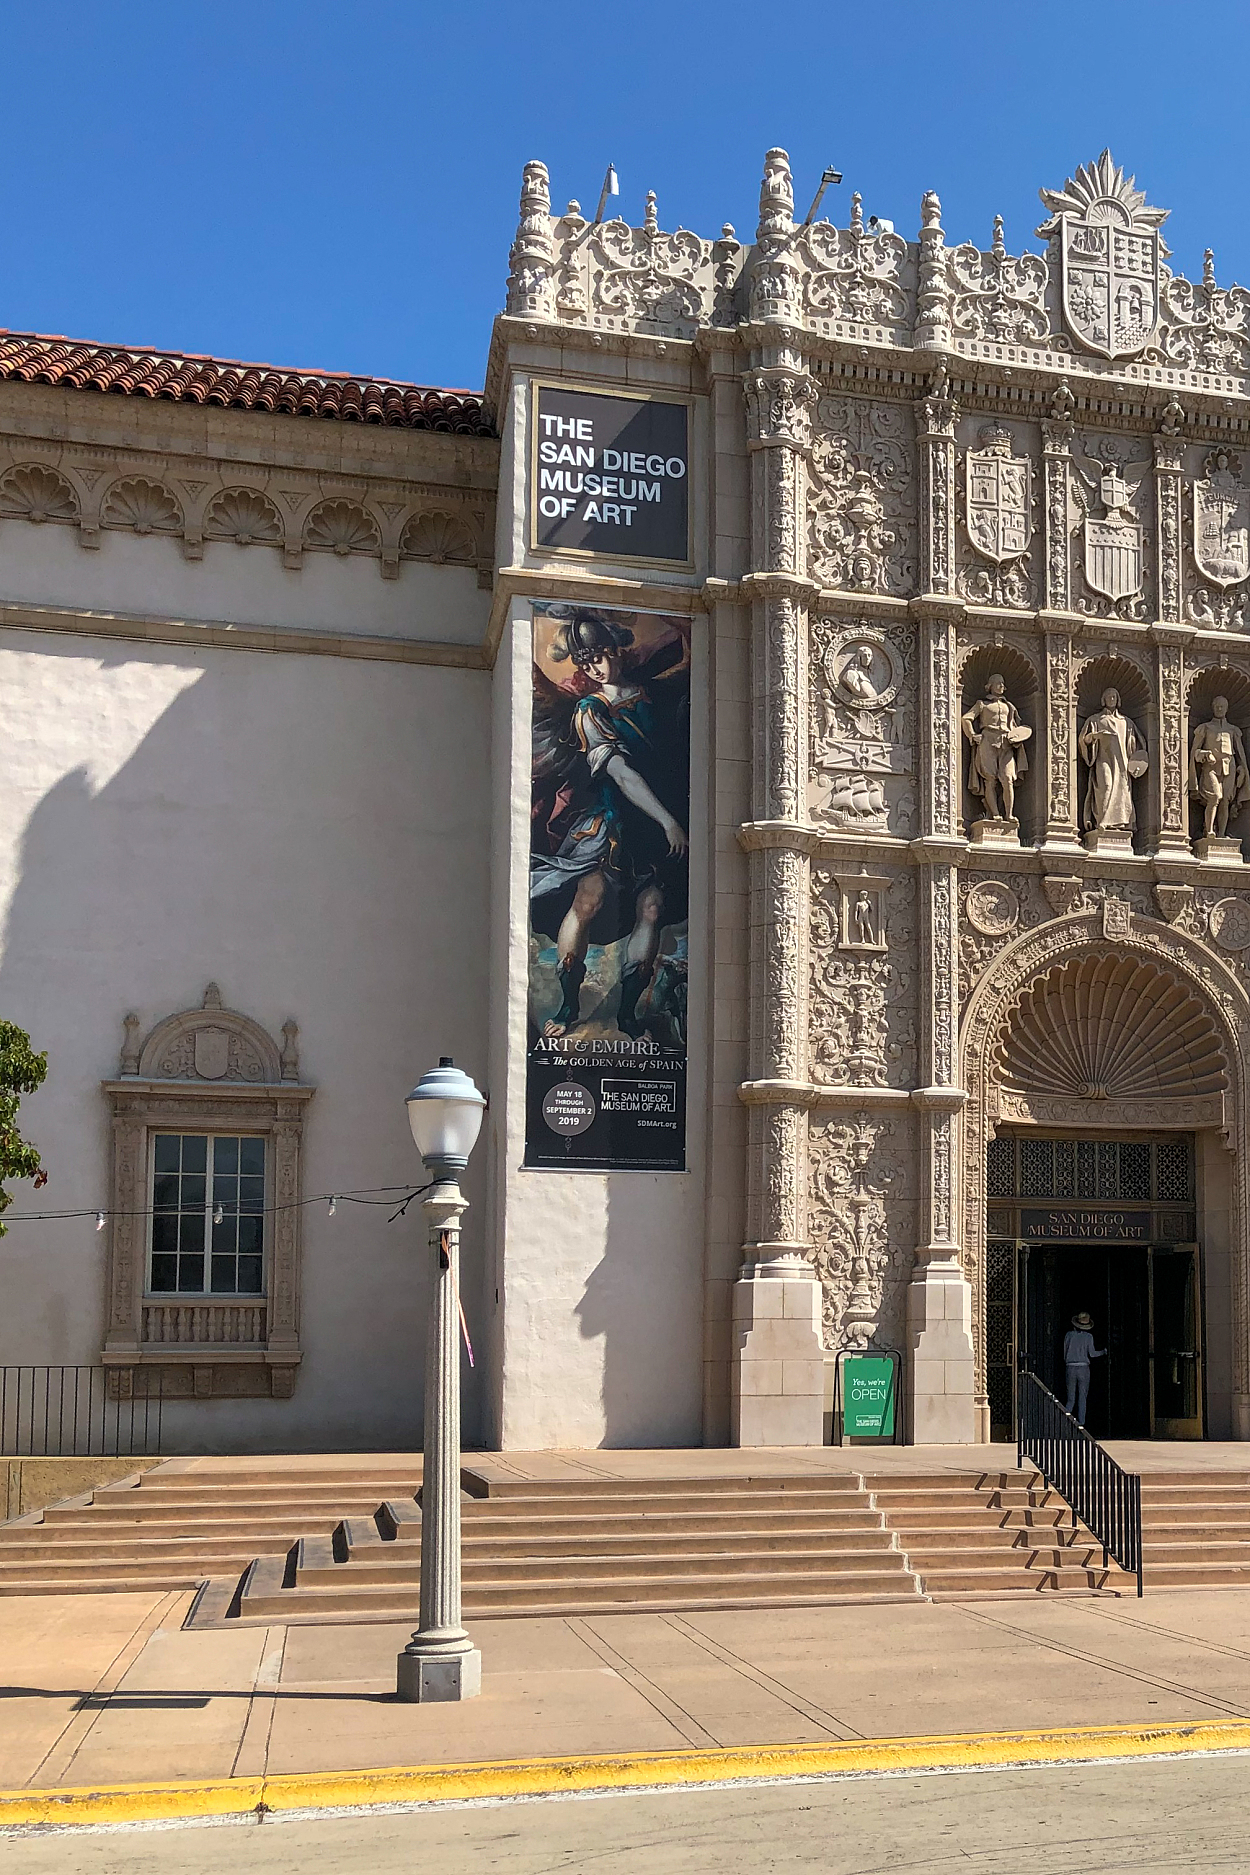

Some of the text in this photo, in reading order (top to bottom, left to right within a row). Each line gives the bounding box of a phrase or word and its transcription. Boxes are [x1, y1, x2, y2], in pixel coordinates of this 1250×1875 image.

[540, 414, 593, 440] THE
[540, 442, 686, 479] SAN DIEGO
[540, 469, 661, 502] MUSEUM
[540, 495, 637, 526] OF ART
[534, 1037, 660, 1056] ART & EMPIRE
[553, 1056, 684, 1072] The GOLDEN AGE of SPAIN
[602, 1092, 668, 1102] THE SAN DIEGO
[601, 1101, 640, 1110] MUSEUM
[642, 1103, 653, 1111] OF
[558, 1117, 579, 1125] 2019
[638, 1120, 676, 1129] SDMArt.org
[1049, 1213, 1124, 1224] SAN DIEGO
[1028, 1225, 1143, 1237] MUSEUM OF ART
[852, 1389, 886, 1400] OPEN
